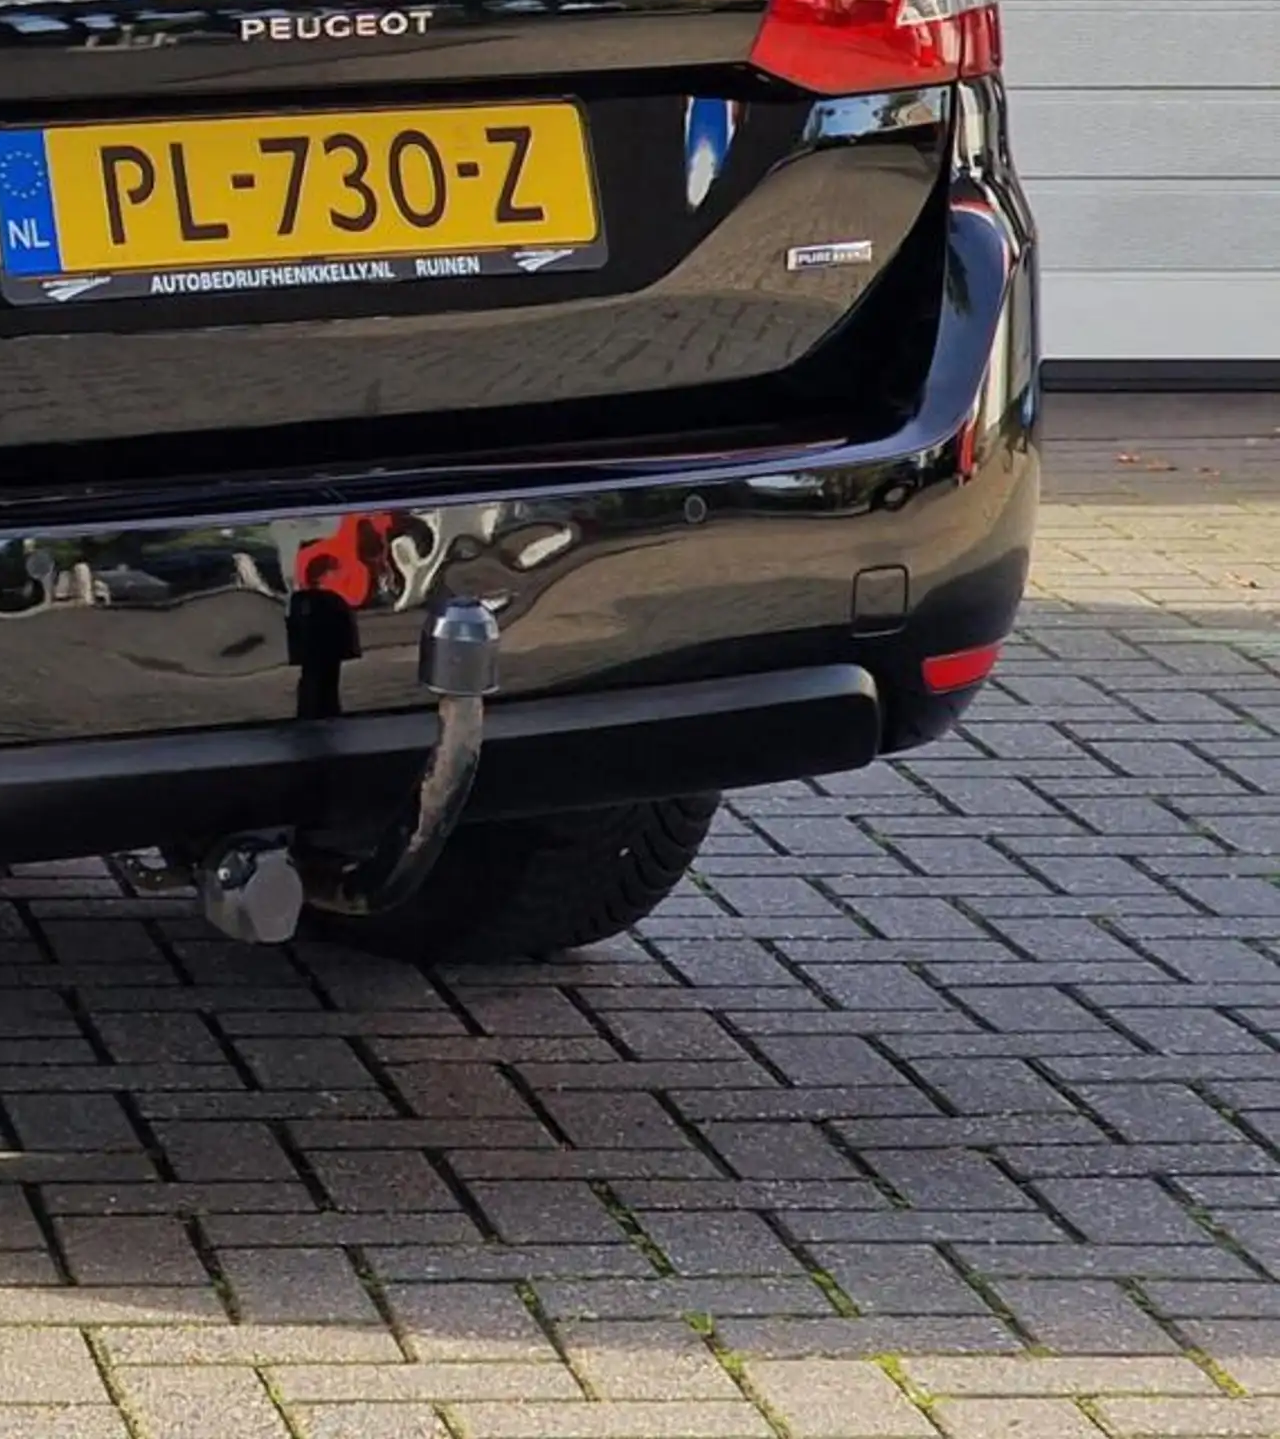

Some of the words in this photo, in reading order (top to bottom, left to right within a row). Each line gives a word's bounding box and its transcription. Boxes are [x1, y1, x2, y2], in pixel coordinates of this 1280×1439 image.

[240, 10, 434, 42] PEUGEOT
[98, 125, 545, 247] PL-730-Z
[7, 217, 51, 250] NL
[150, 260, 396, 294] AUTOBEDRIJFHENKKELLY.NL
[414, 255, 482, 277] RUINEN
